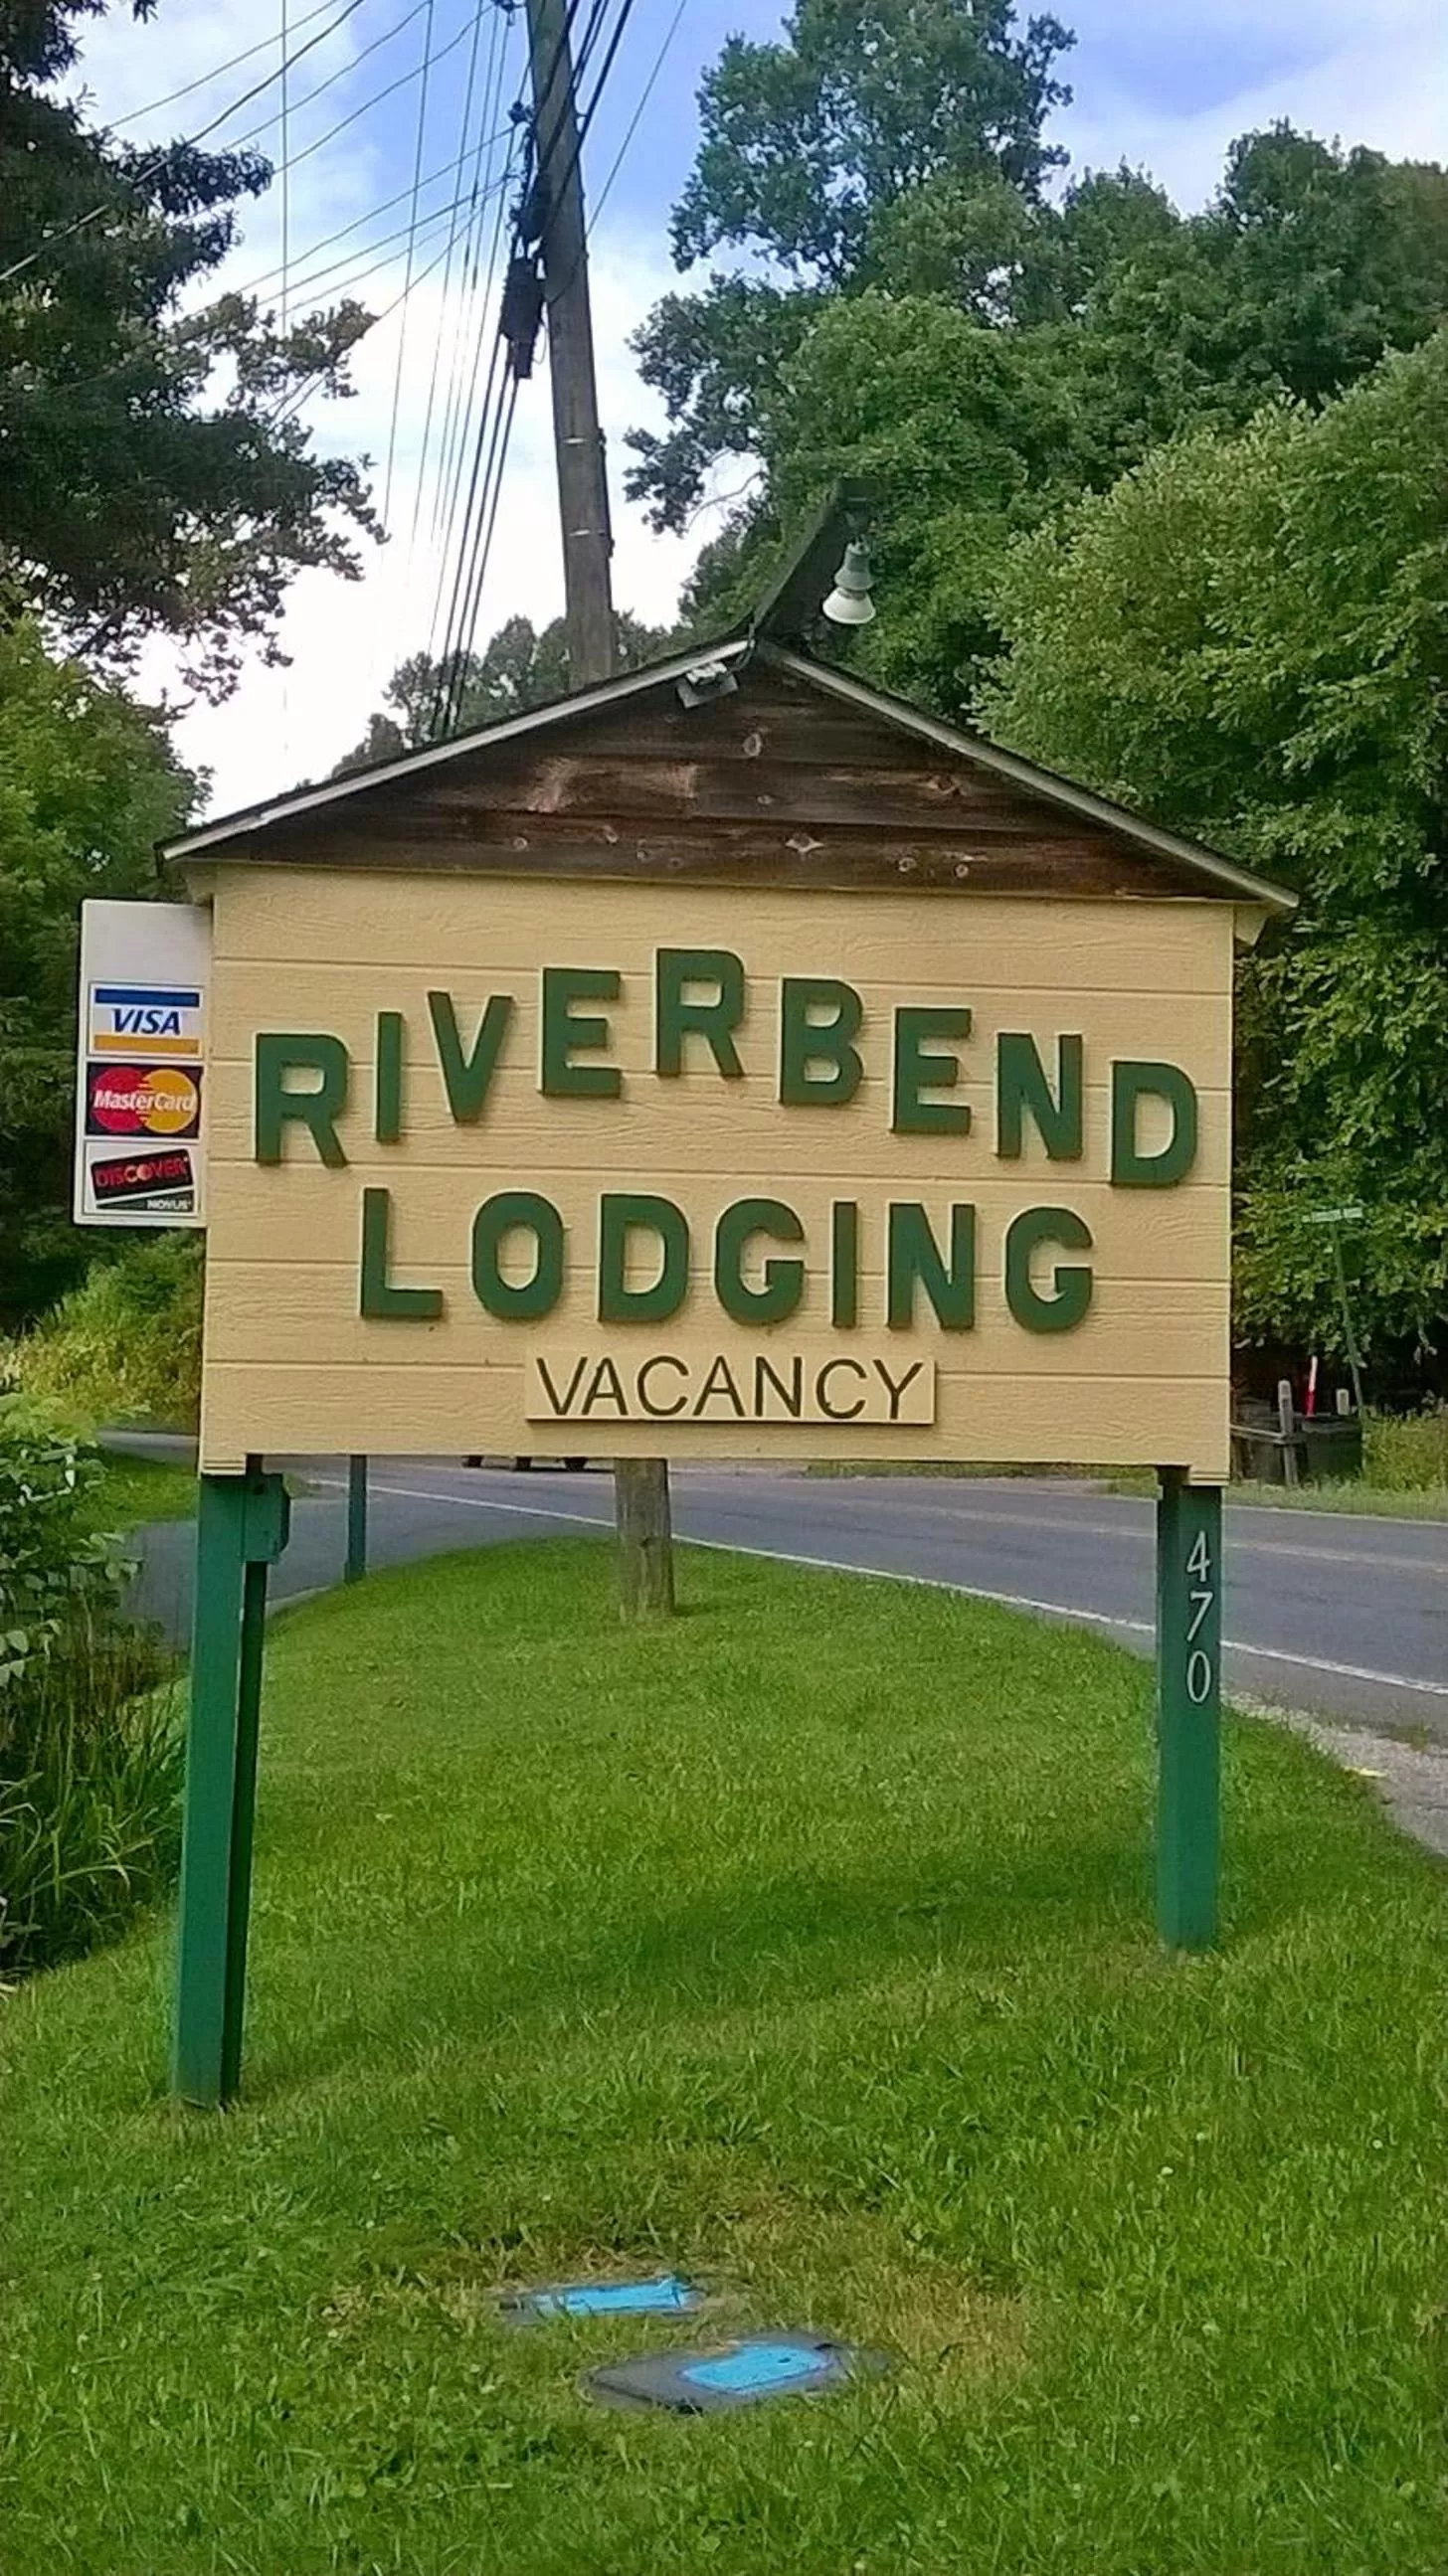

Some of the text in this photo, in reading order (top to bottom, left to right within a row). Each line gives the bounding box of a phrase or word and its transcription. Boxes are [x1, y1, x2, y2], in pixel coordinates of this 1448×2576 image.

[112, 1009, 180, 1035] VISA
[255, 948, 1197, 1187] RIVERBEND
[93, 1091, 194, 1113] MasterCard
[94, 1157, 186, 1186] DISCOVER
[362, 1188, 1094, 1330] LODGING
[537, 1355, 923, 1419] VACANCY
[1186, 1530, 1212, 1704] 470
